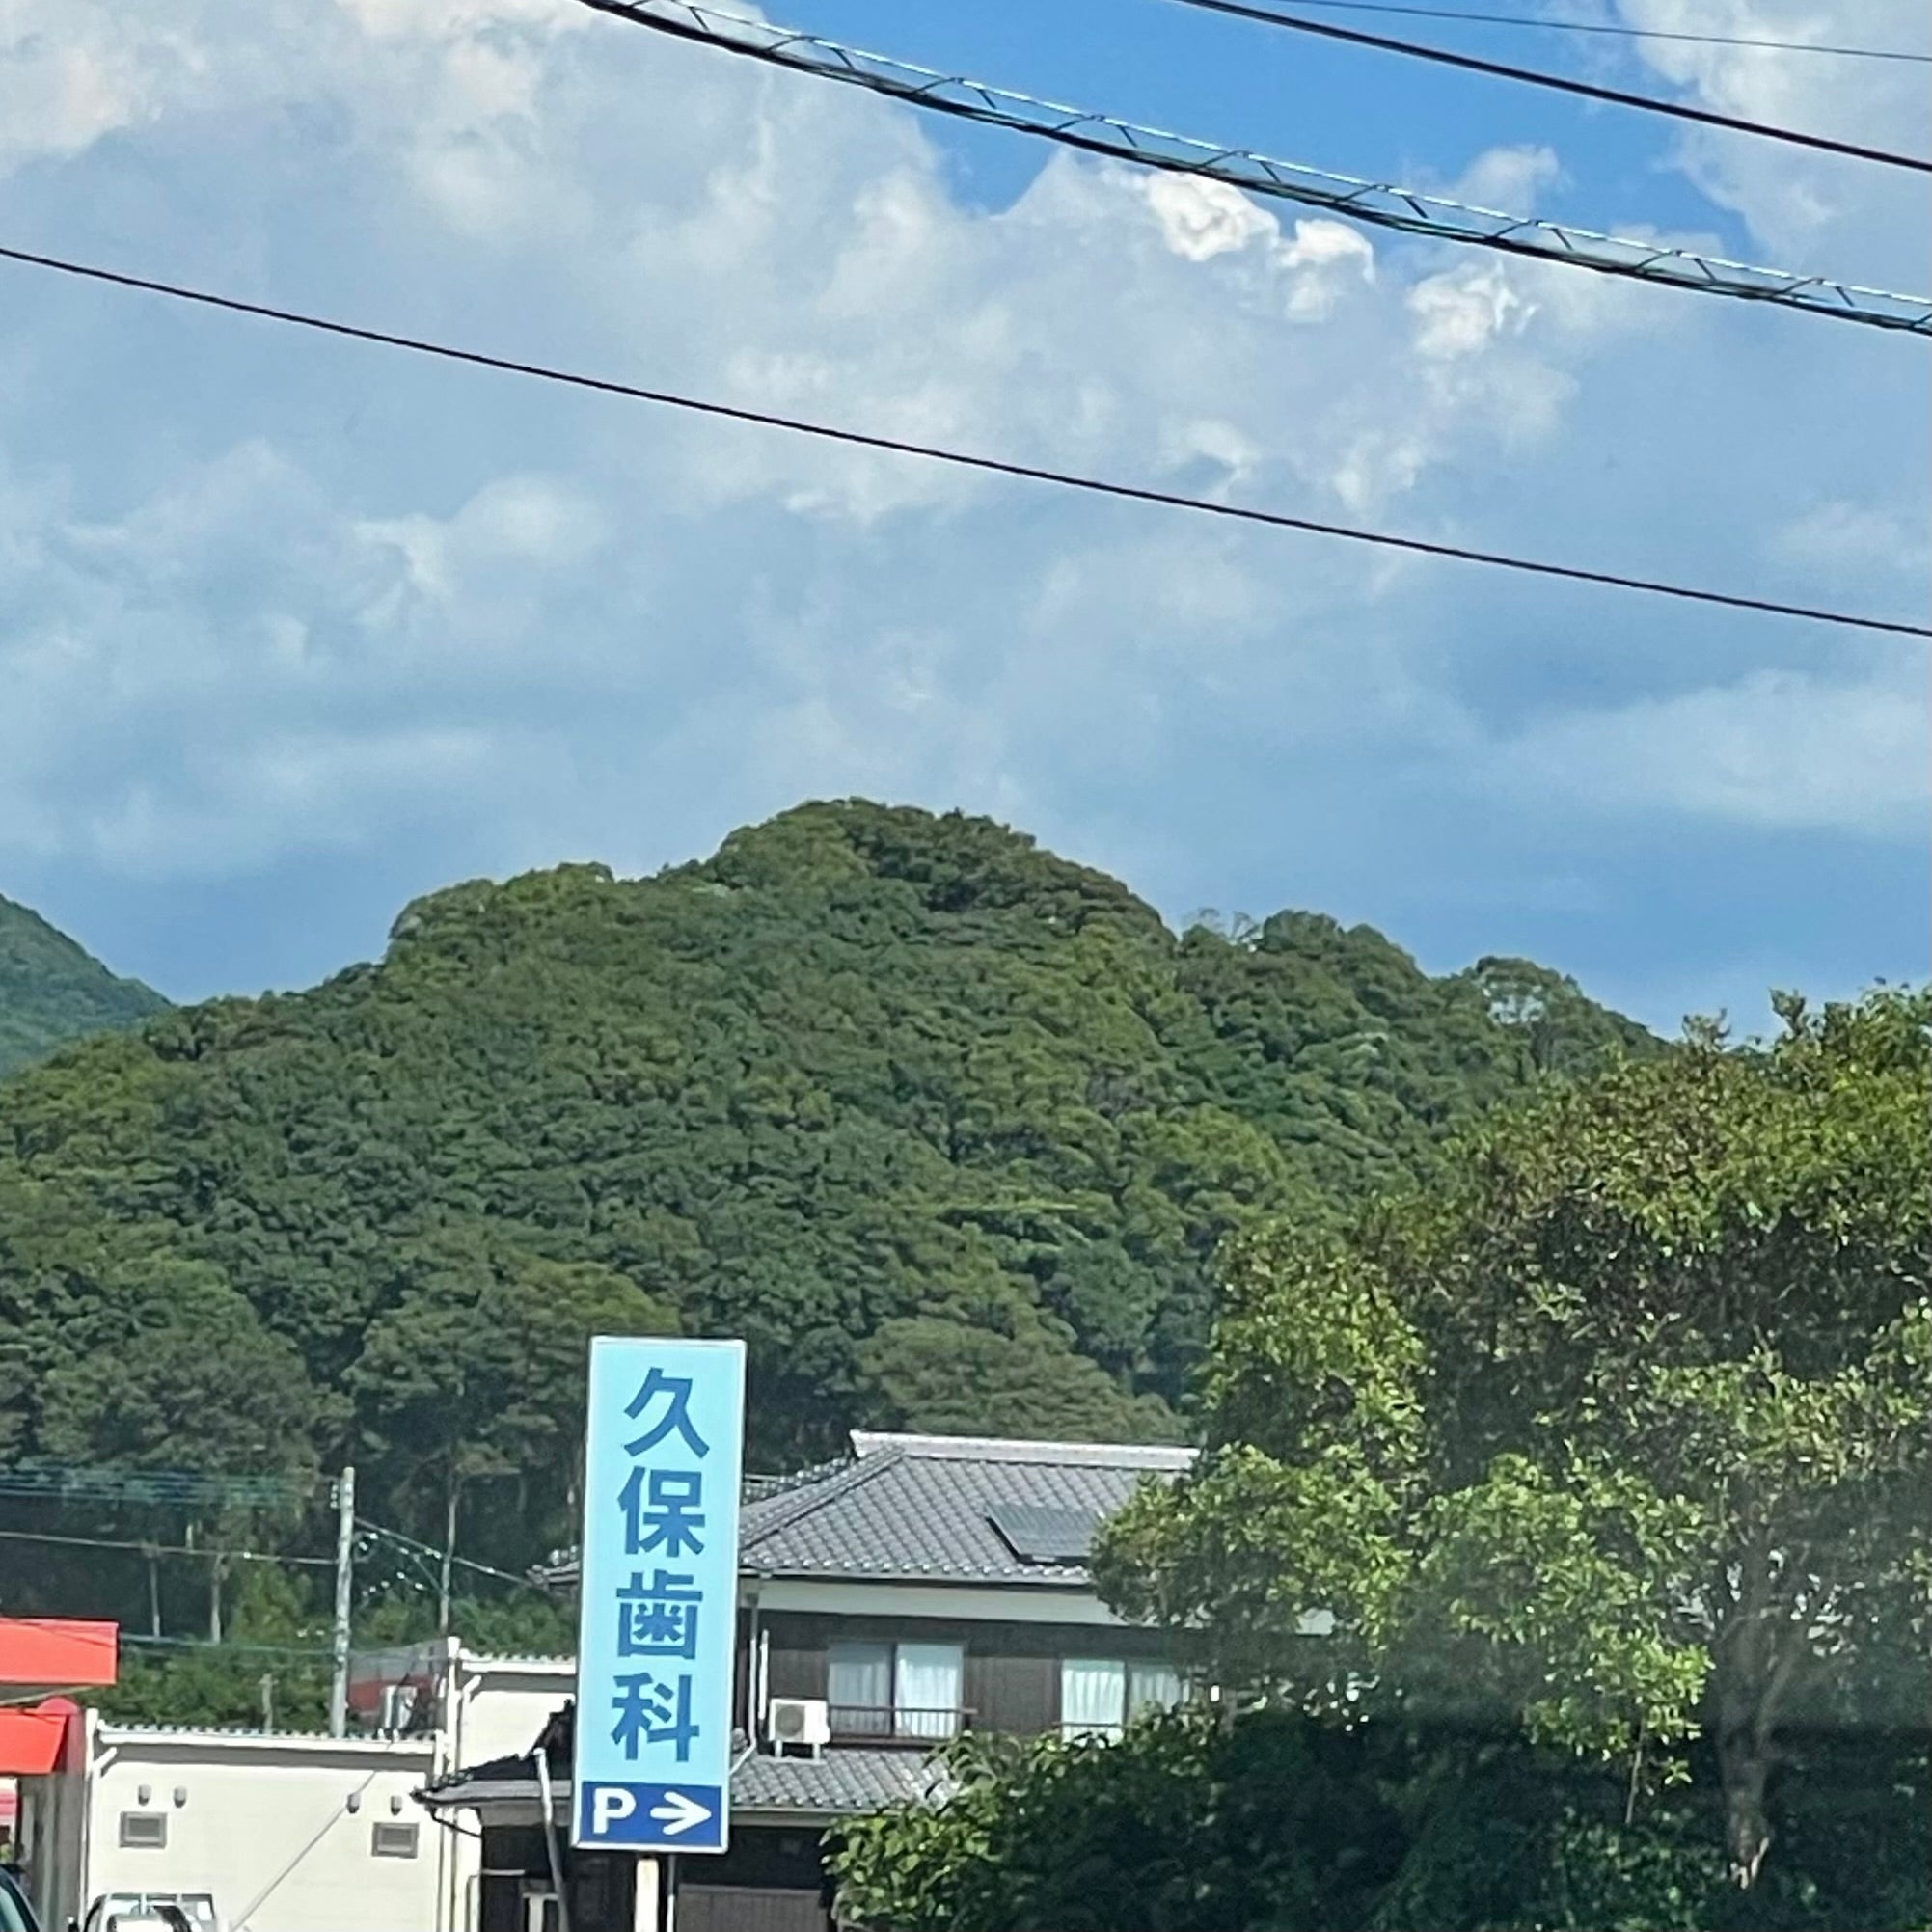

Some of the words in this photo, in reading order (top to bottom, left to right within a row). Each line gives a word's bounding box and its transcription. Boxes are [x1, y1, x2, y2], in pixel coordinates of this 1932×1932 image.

[611, 1367, 710, 1762] 久保歯科
[592, 1787, 637, 1835] P
